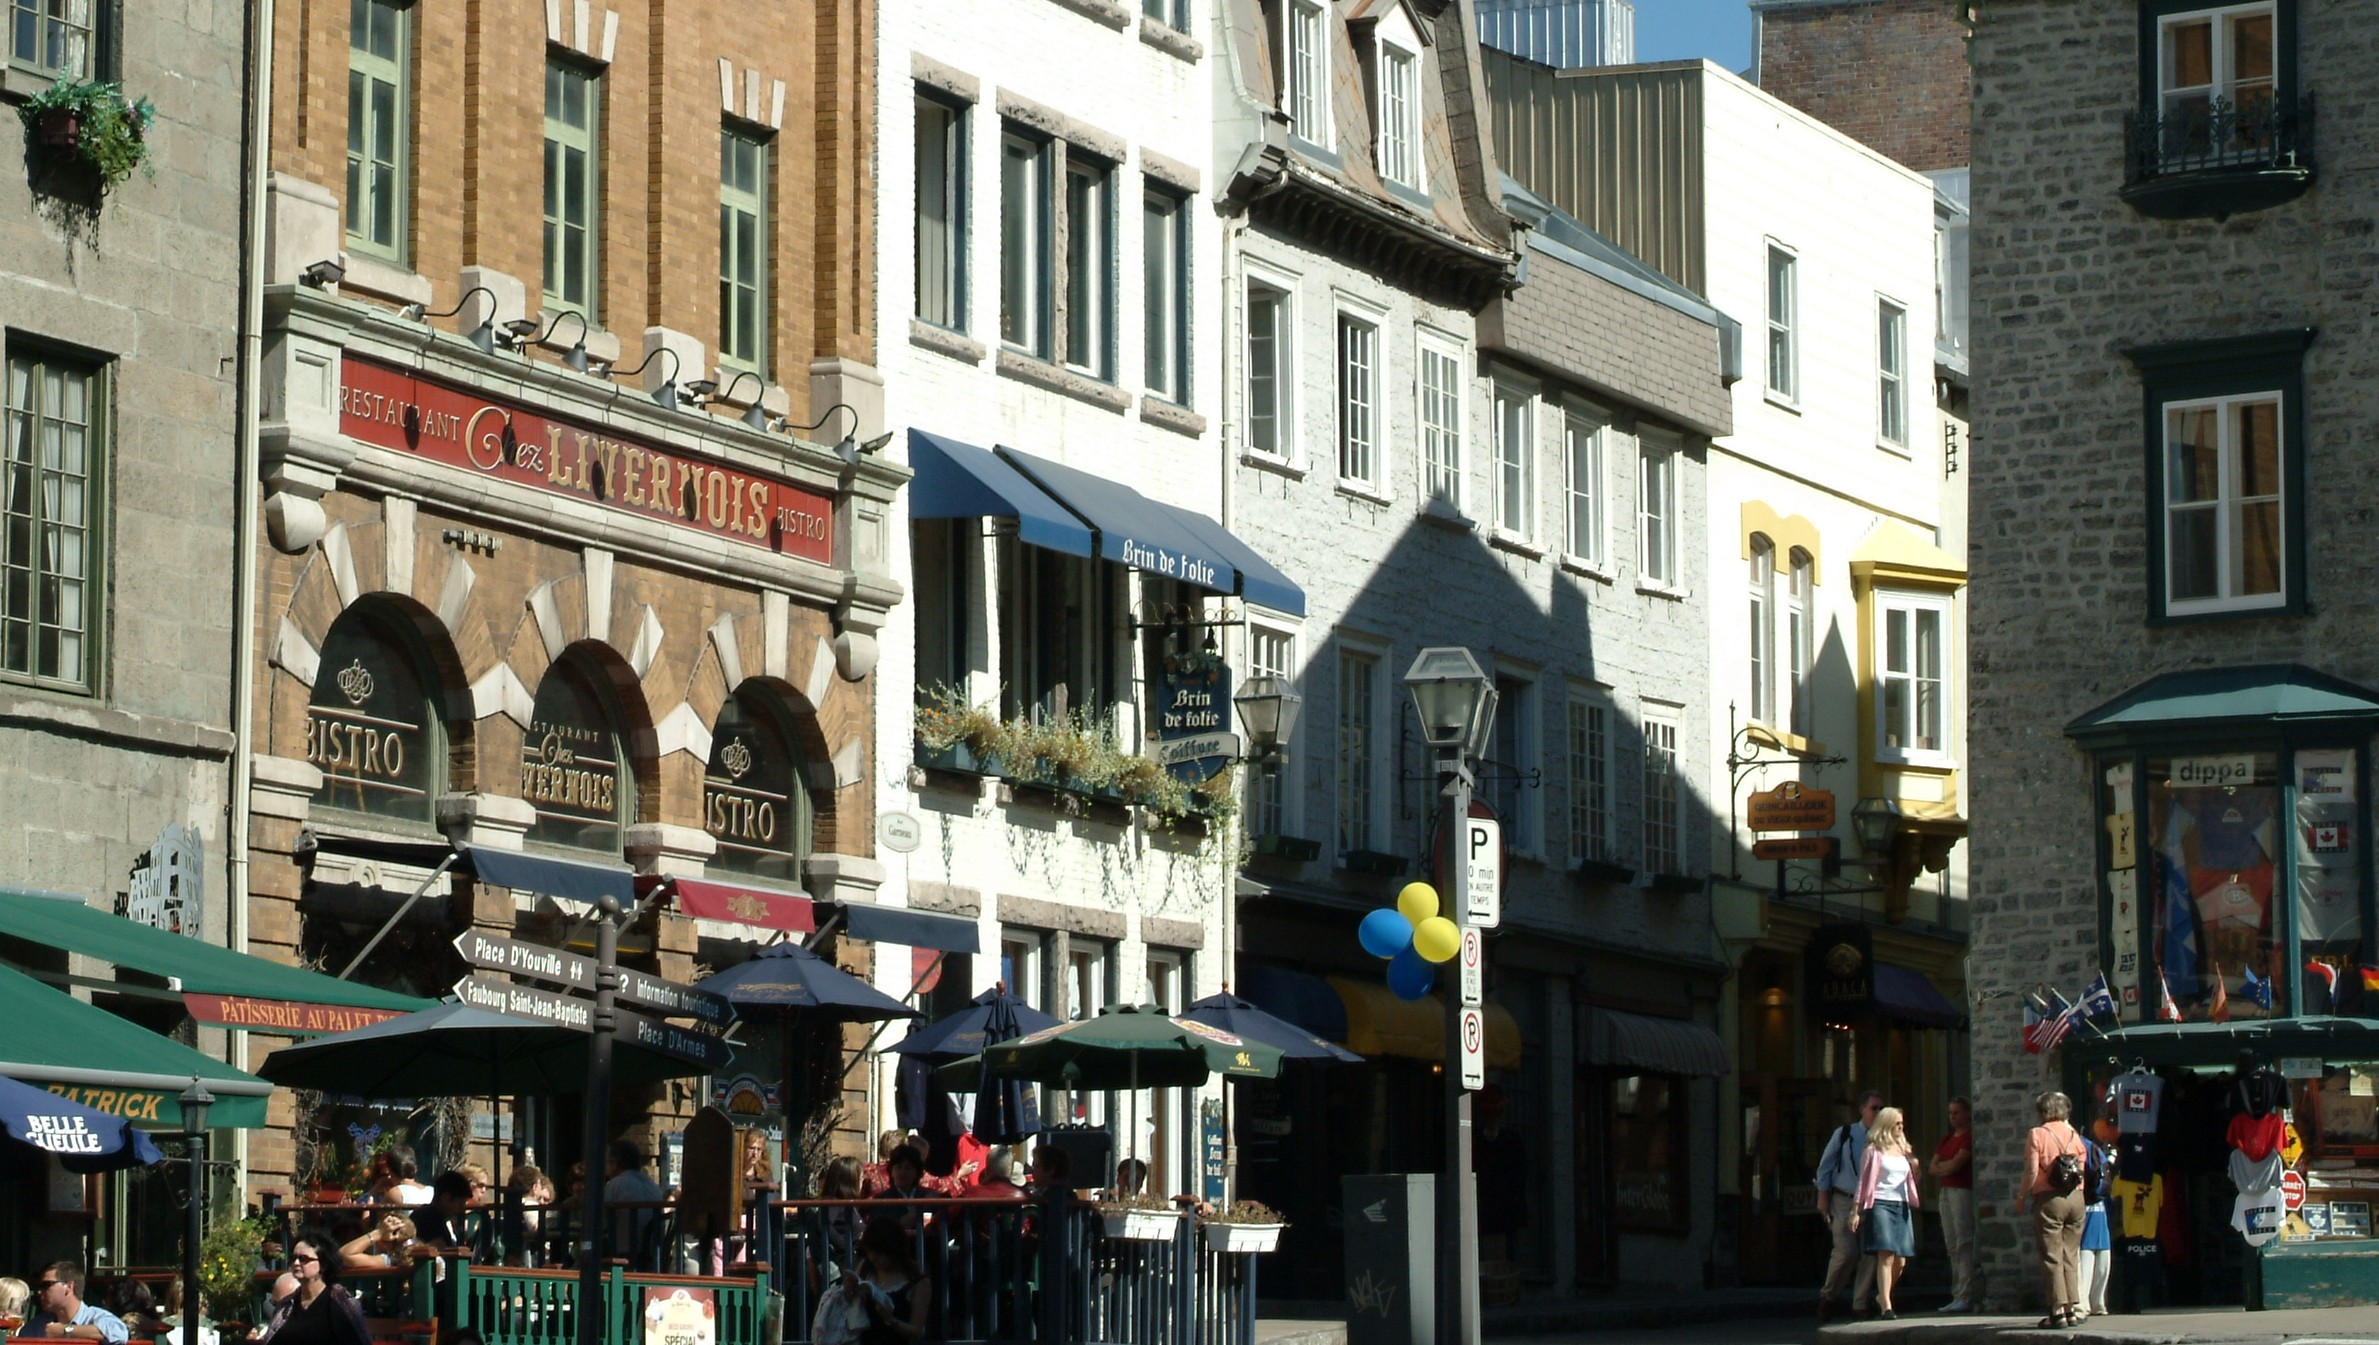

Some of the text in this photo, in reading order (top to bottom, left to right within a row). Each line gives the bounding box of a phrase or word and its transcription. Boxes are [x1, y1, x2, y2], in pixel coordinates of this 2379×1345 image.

[547, 425, 769, 540] LIVERNOIS
[776, 506, 826, 541] BISTRO
[1122, 538, 1155, 570] Brin
[1160, 549, 1175, 575] de
[1171, 689, 1211, 709] Brin
[533, 720, 599, 743] STAURANT
[1164, 712, 1182, 728] de
[2180, 761, 2247, 784] dippa
[521, 762, 615, 812] VERNOIS
[705, 791, 775, 841] ISTRO
[1471, 827, 1488, 860] P
[1479, 866, 1494, 880] min
[1470, 895, 1489, 906] TEMPS
[1475, 882, 1494, 893] AUTRE
[475, 938, 562, 976] Place D'Youville
[220, 996, 303, 1029] PÂTISSERIE
[307, 1009, 325, 1030] AU
[467, 981, 588, 1027] Faubourg Saint-Jean-Baptiste
[637, 978, 679, 1008] Information
[682, 992, 719, 1021] touristique
[638, 1021, 706, 1058] Place D'Armes
[27, 1115, 88, 1134] BELLE
[26, 1132, 102, 1152] GUEULE
[2128, 1245, 2157, 1253] POLICE
